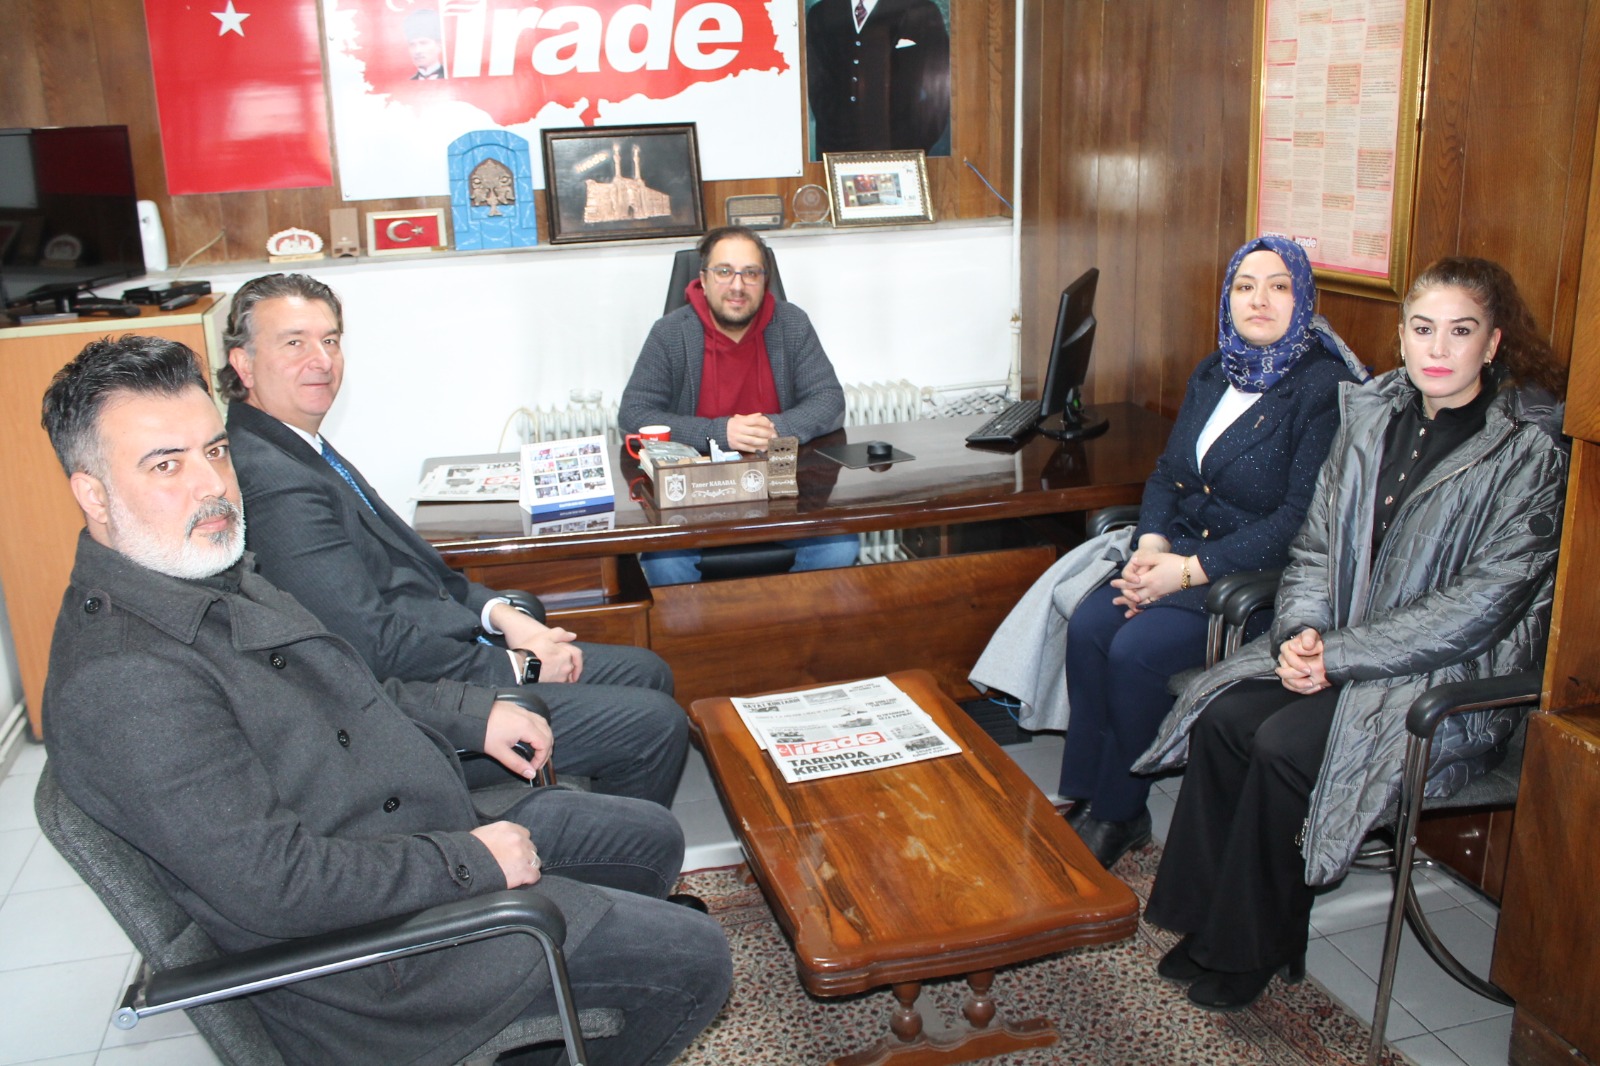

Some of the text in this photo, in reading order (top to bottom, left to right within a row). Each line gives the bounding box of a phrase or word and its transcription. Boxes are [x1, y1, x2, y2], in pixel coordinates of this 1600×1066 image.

[446, 0, 744, 79] irade
[792, 733, 882, 756] irade
[788, 751, 869, 767] TARIMDA
[792, 761, 849, 776] KREDİ
